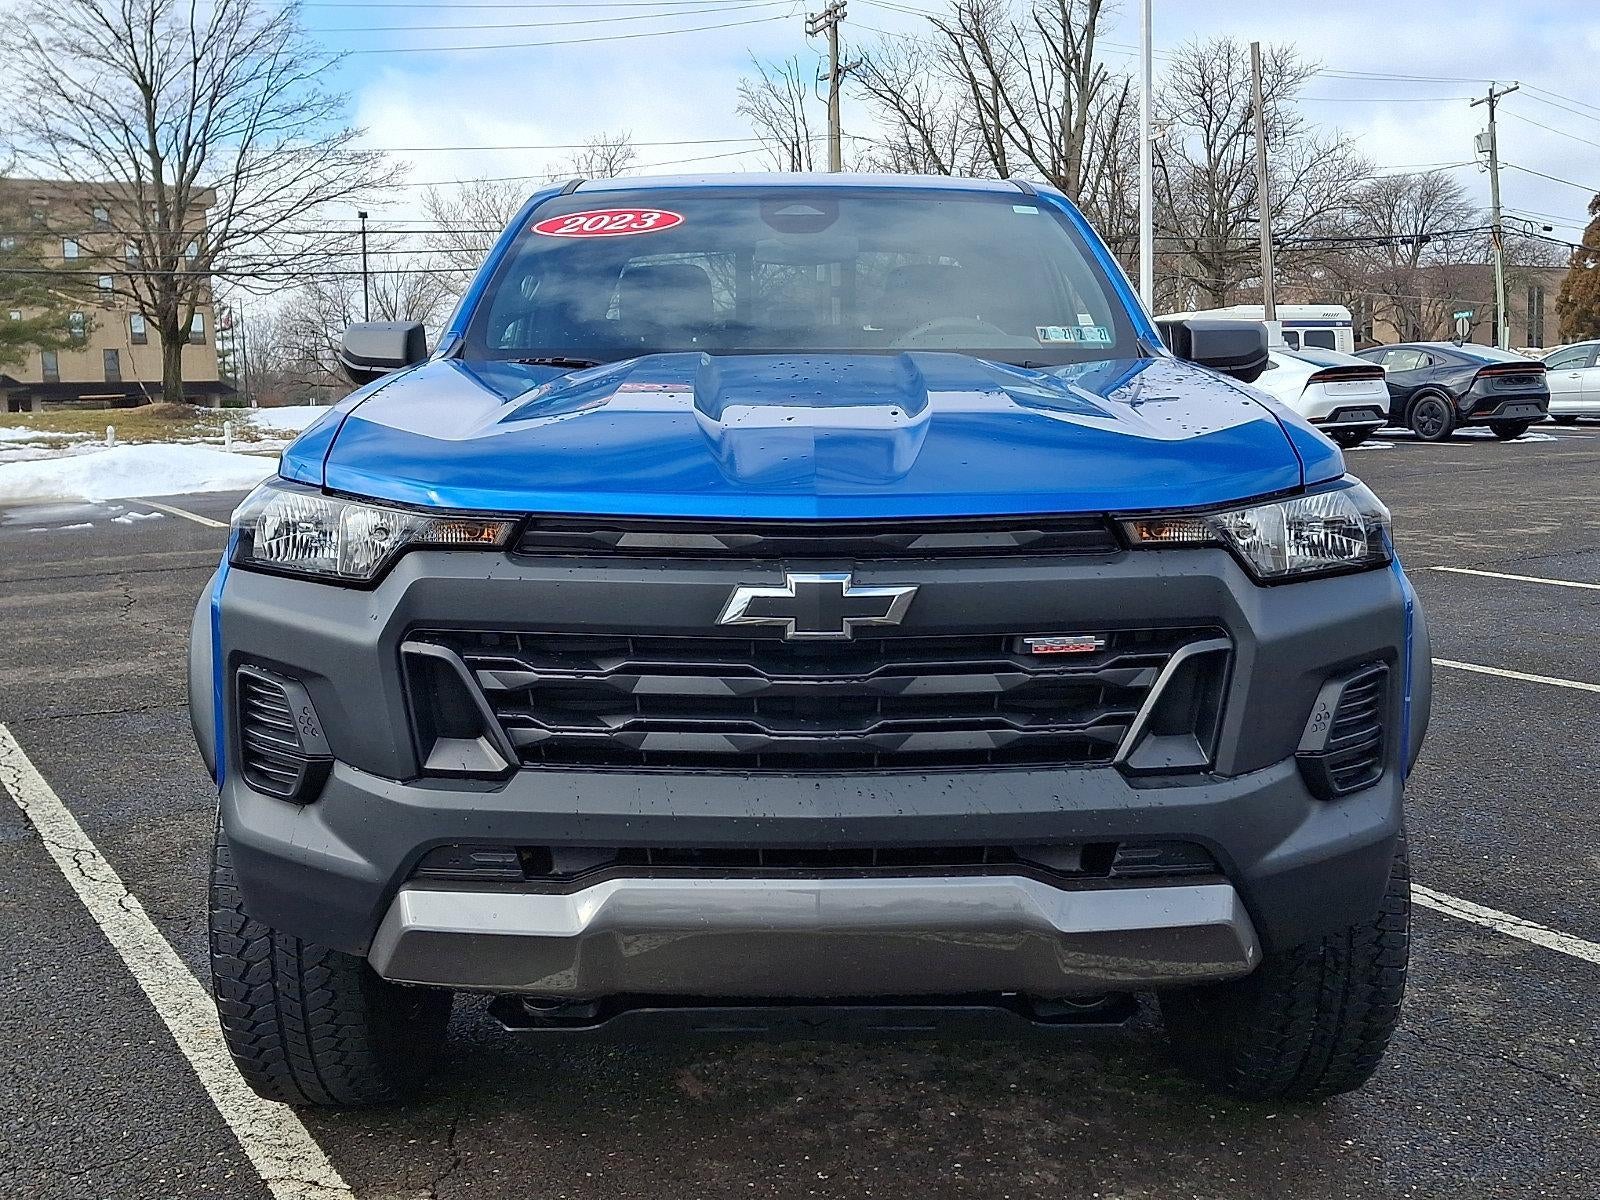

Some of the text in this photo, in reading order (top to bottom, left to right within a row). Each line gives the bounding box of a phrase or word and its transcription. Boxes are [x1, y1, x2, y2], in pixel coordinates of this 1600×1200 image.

[554, 213, 661, 234] 2023
[1040, 328, 1049, 340] 2
[1076, 328, 1085, 340] 2
